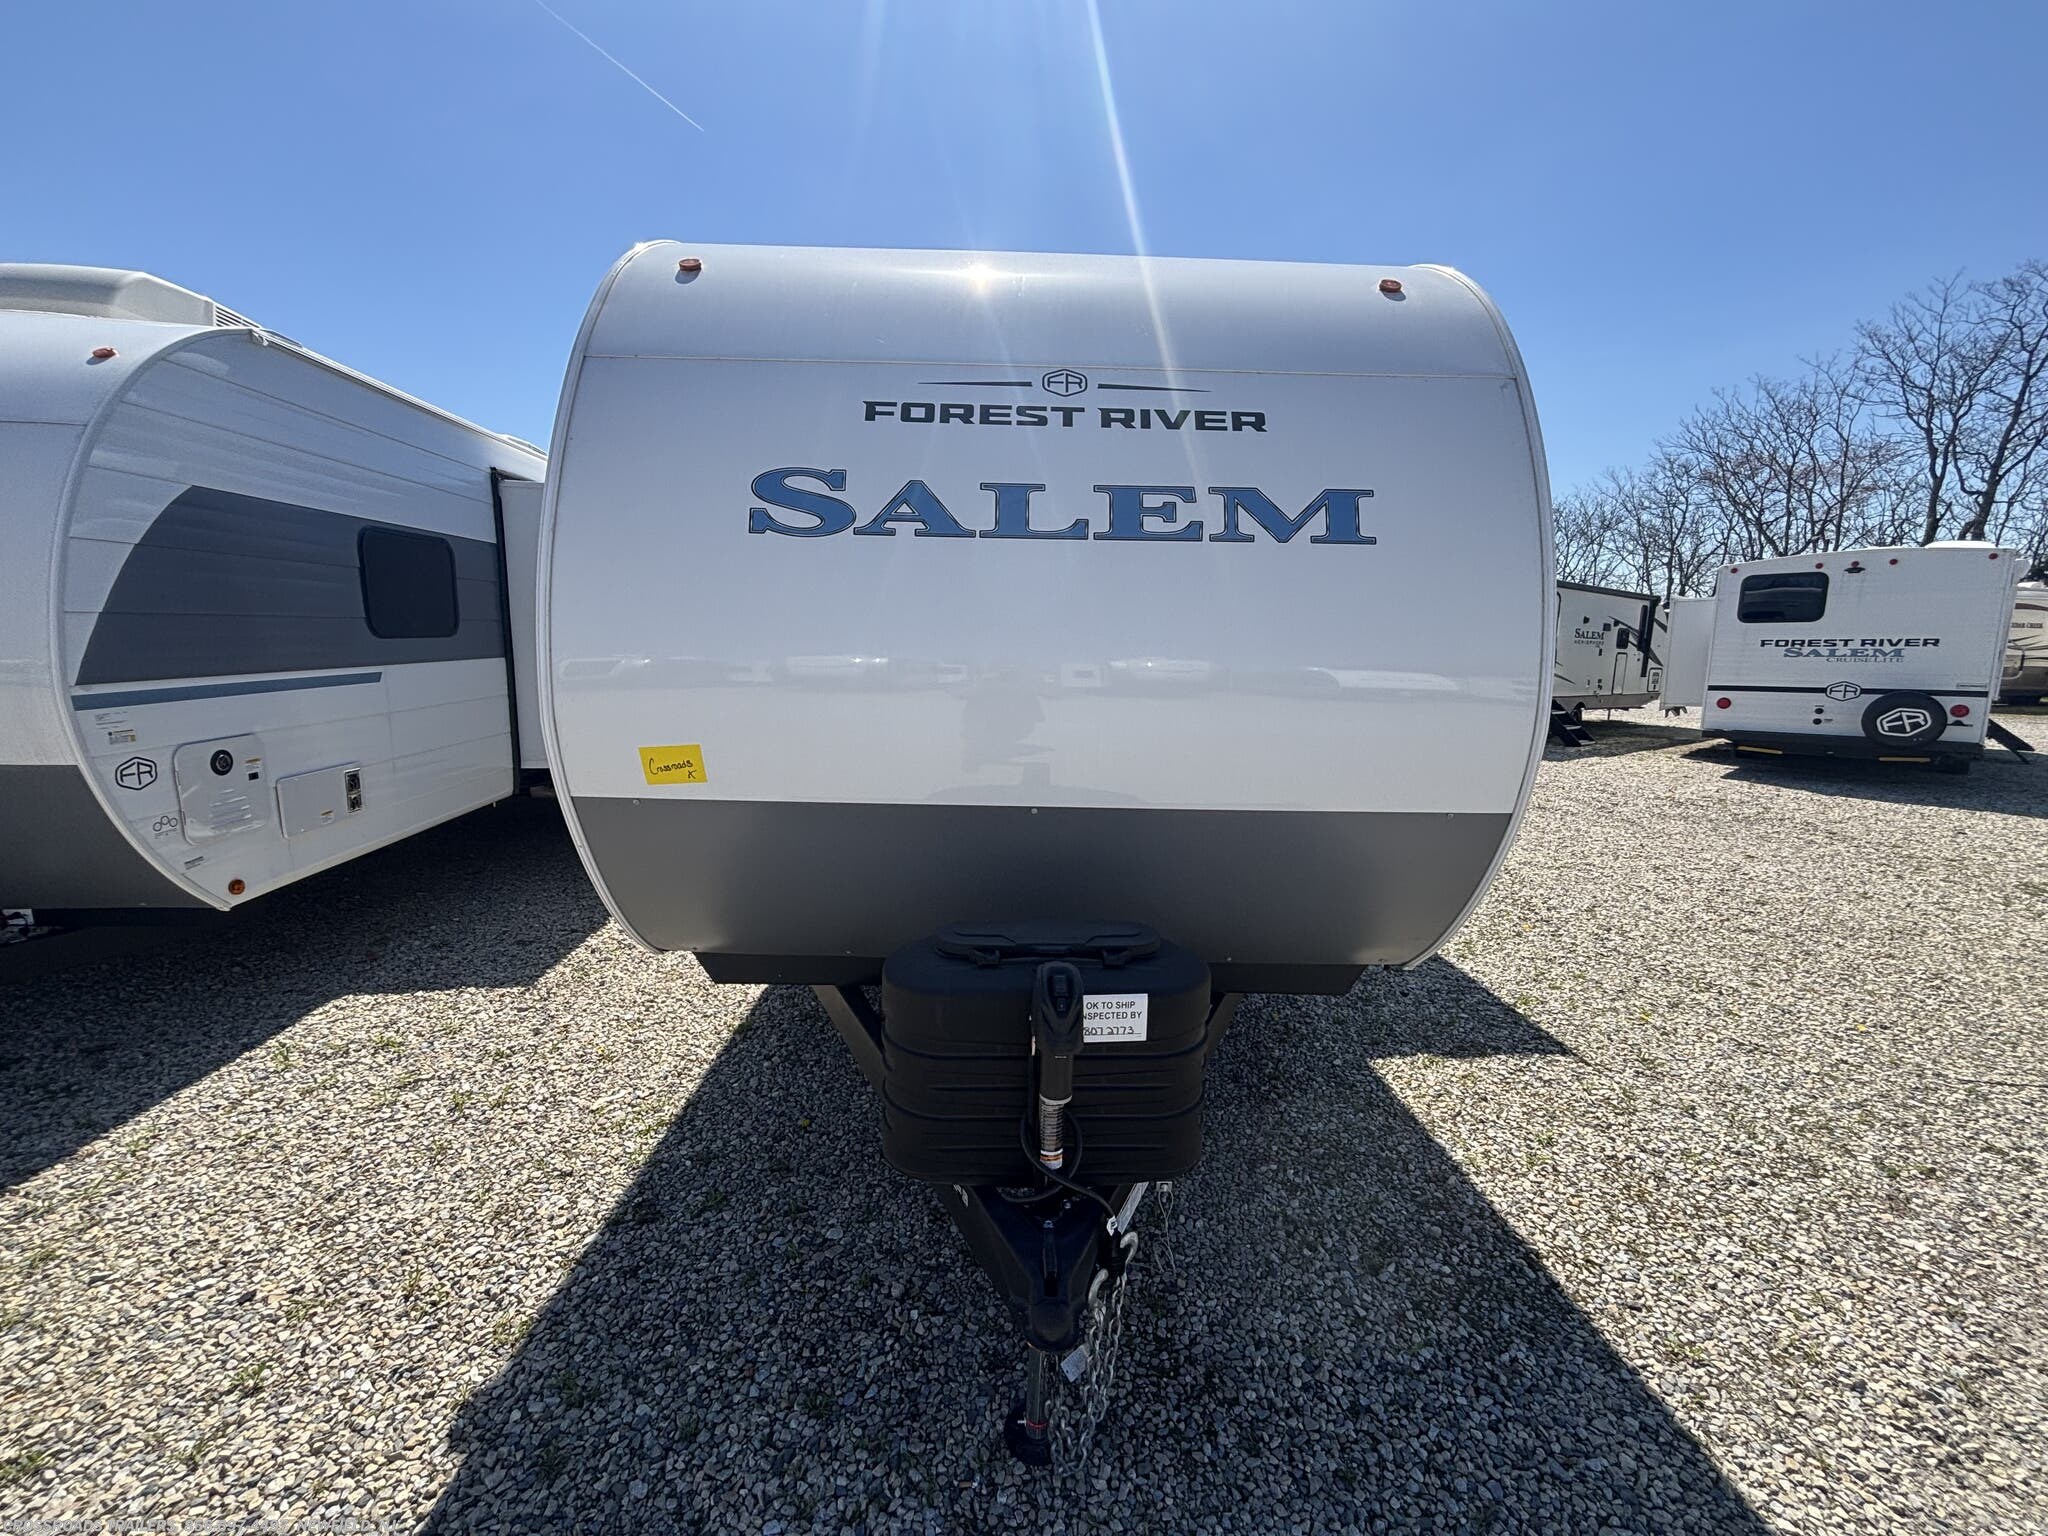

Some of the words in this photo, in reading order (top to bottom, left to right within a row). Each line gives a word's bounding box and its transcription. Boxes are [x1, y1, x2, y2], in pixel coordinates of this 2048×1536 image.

[862, 400, 1085, 428] FOREST
[1098, 407, 1268, 433] RIVER
[748, 466, 1377, 545] SALEM
[1574, 628, 1605, 640] SALEM
[1759, 638, 1855, 648] FOREST
[1860, 638, 1941, 648] RIVER
[1783, 647, 1905, 658] SALEM
[1085, 1001, 1099, 1010] OK
[1101, 1001, 1113, 1009] TO
[1115, 1000, 1136, 1009] SHIP
[1130, 1011, 1142, 1019] BY
